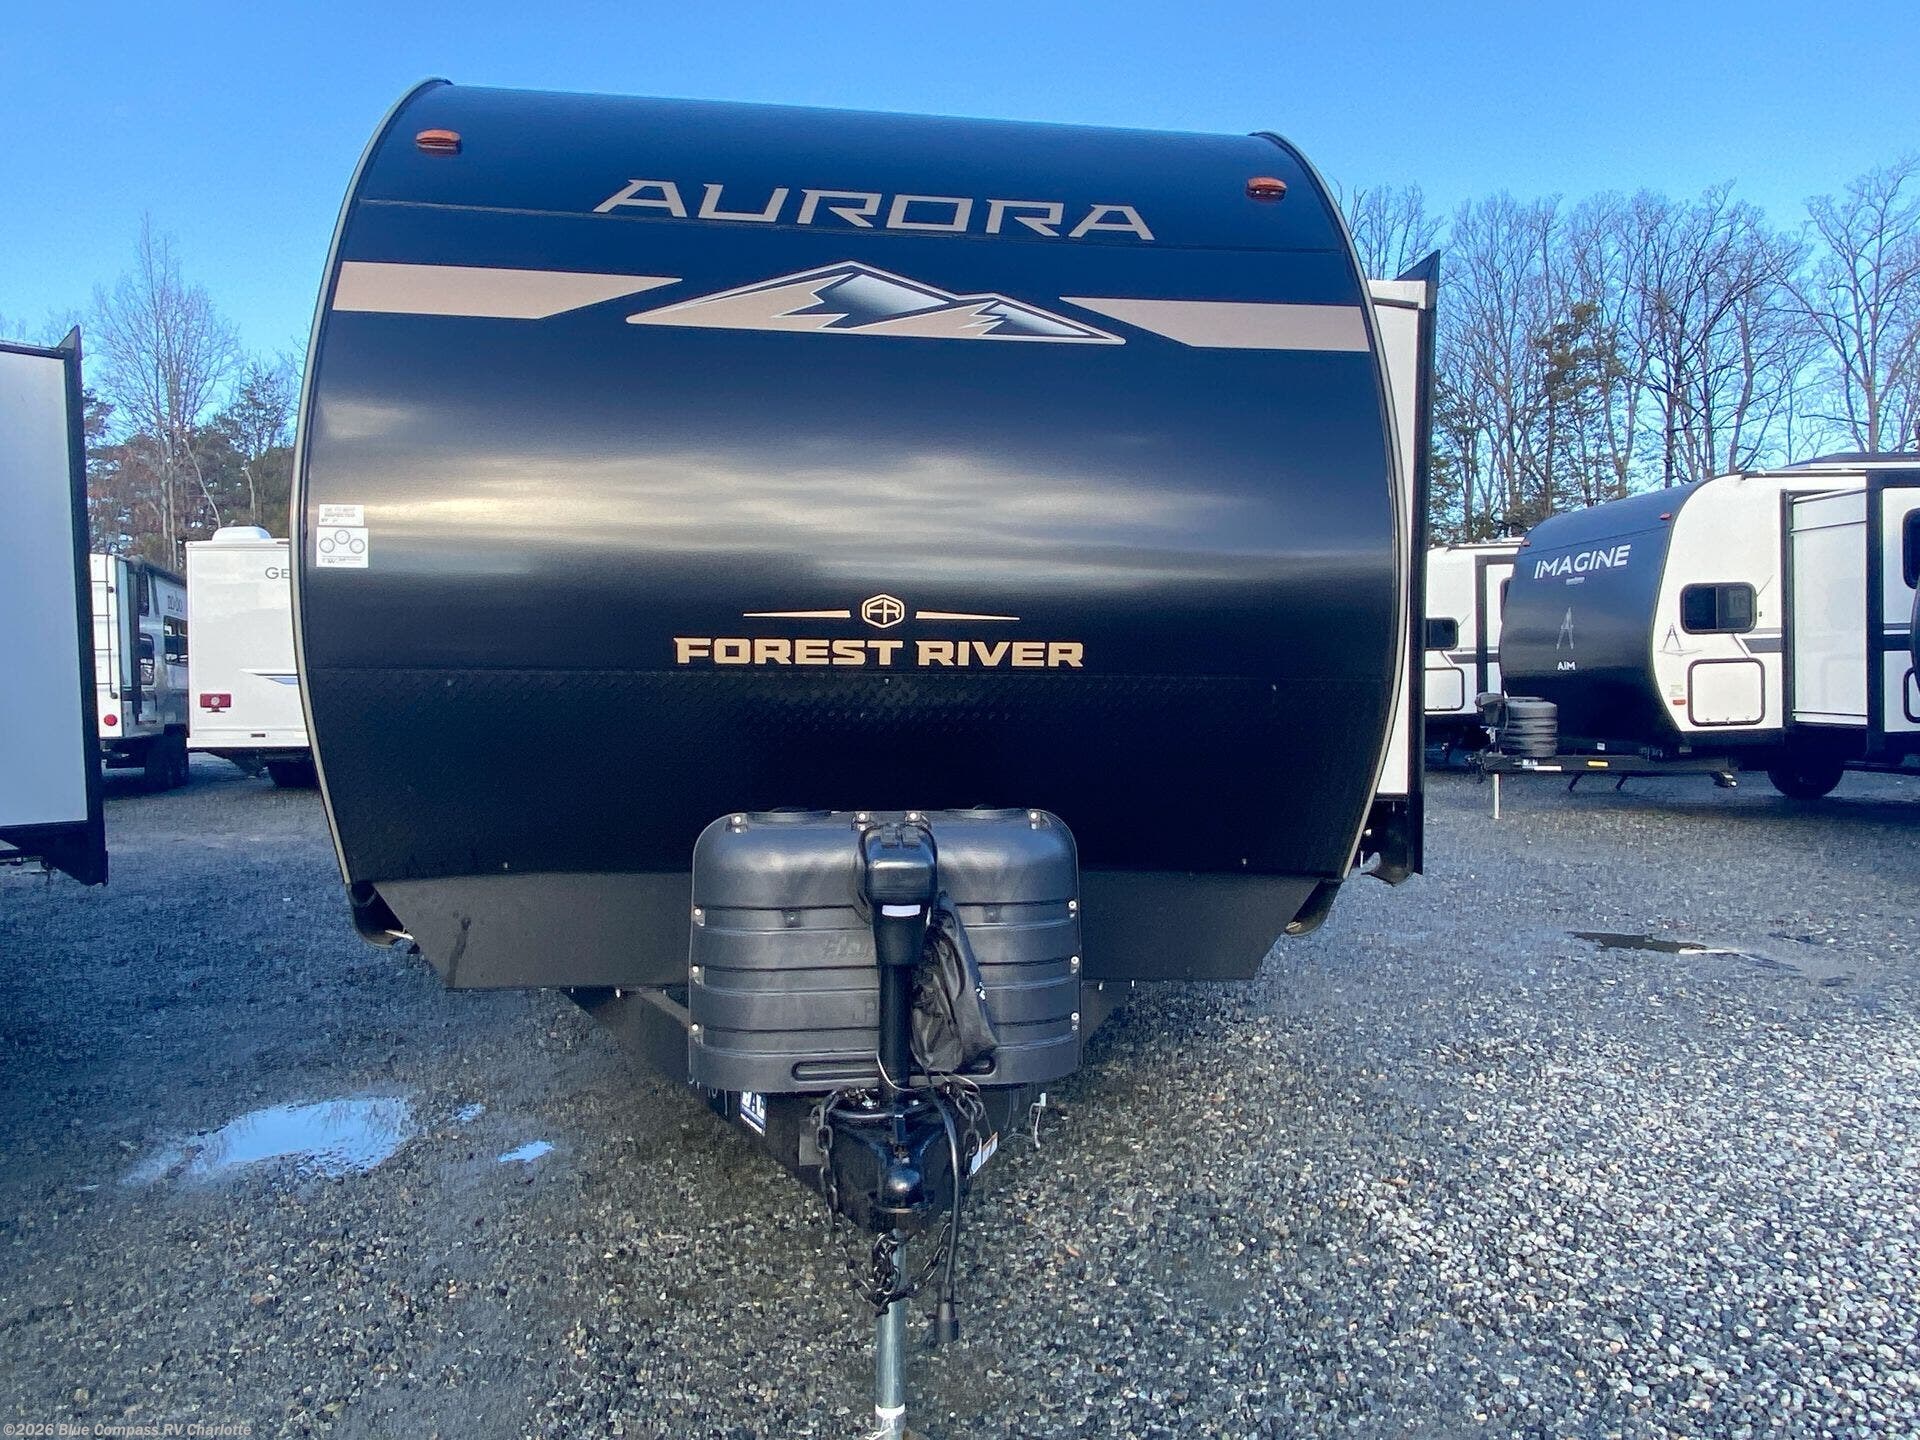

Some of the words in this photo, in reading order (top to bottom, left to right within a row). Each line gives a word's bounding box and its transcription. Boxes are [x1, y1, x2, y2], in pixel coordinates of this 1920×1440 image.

[593, 178, 1155, 241] AURORA
[1533, 544, 1632, 579] IMAGINE
[673, 637, 904, 667] FOREST
[914, 640, 1084, 669] RIVER
[1557, 660, 1577, 671] AIM
